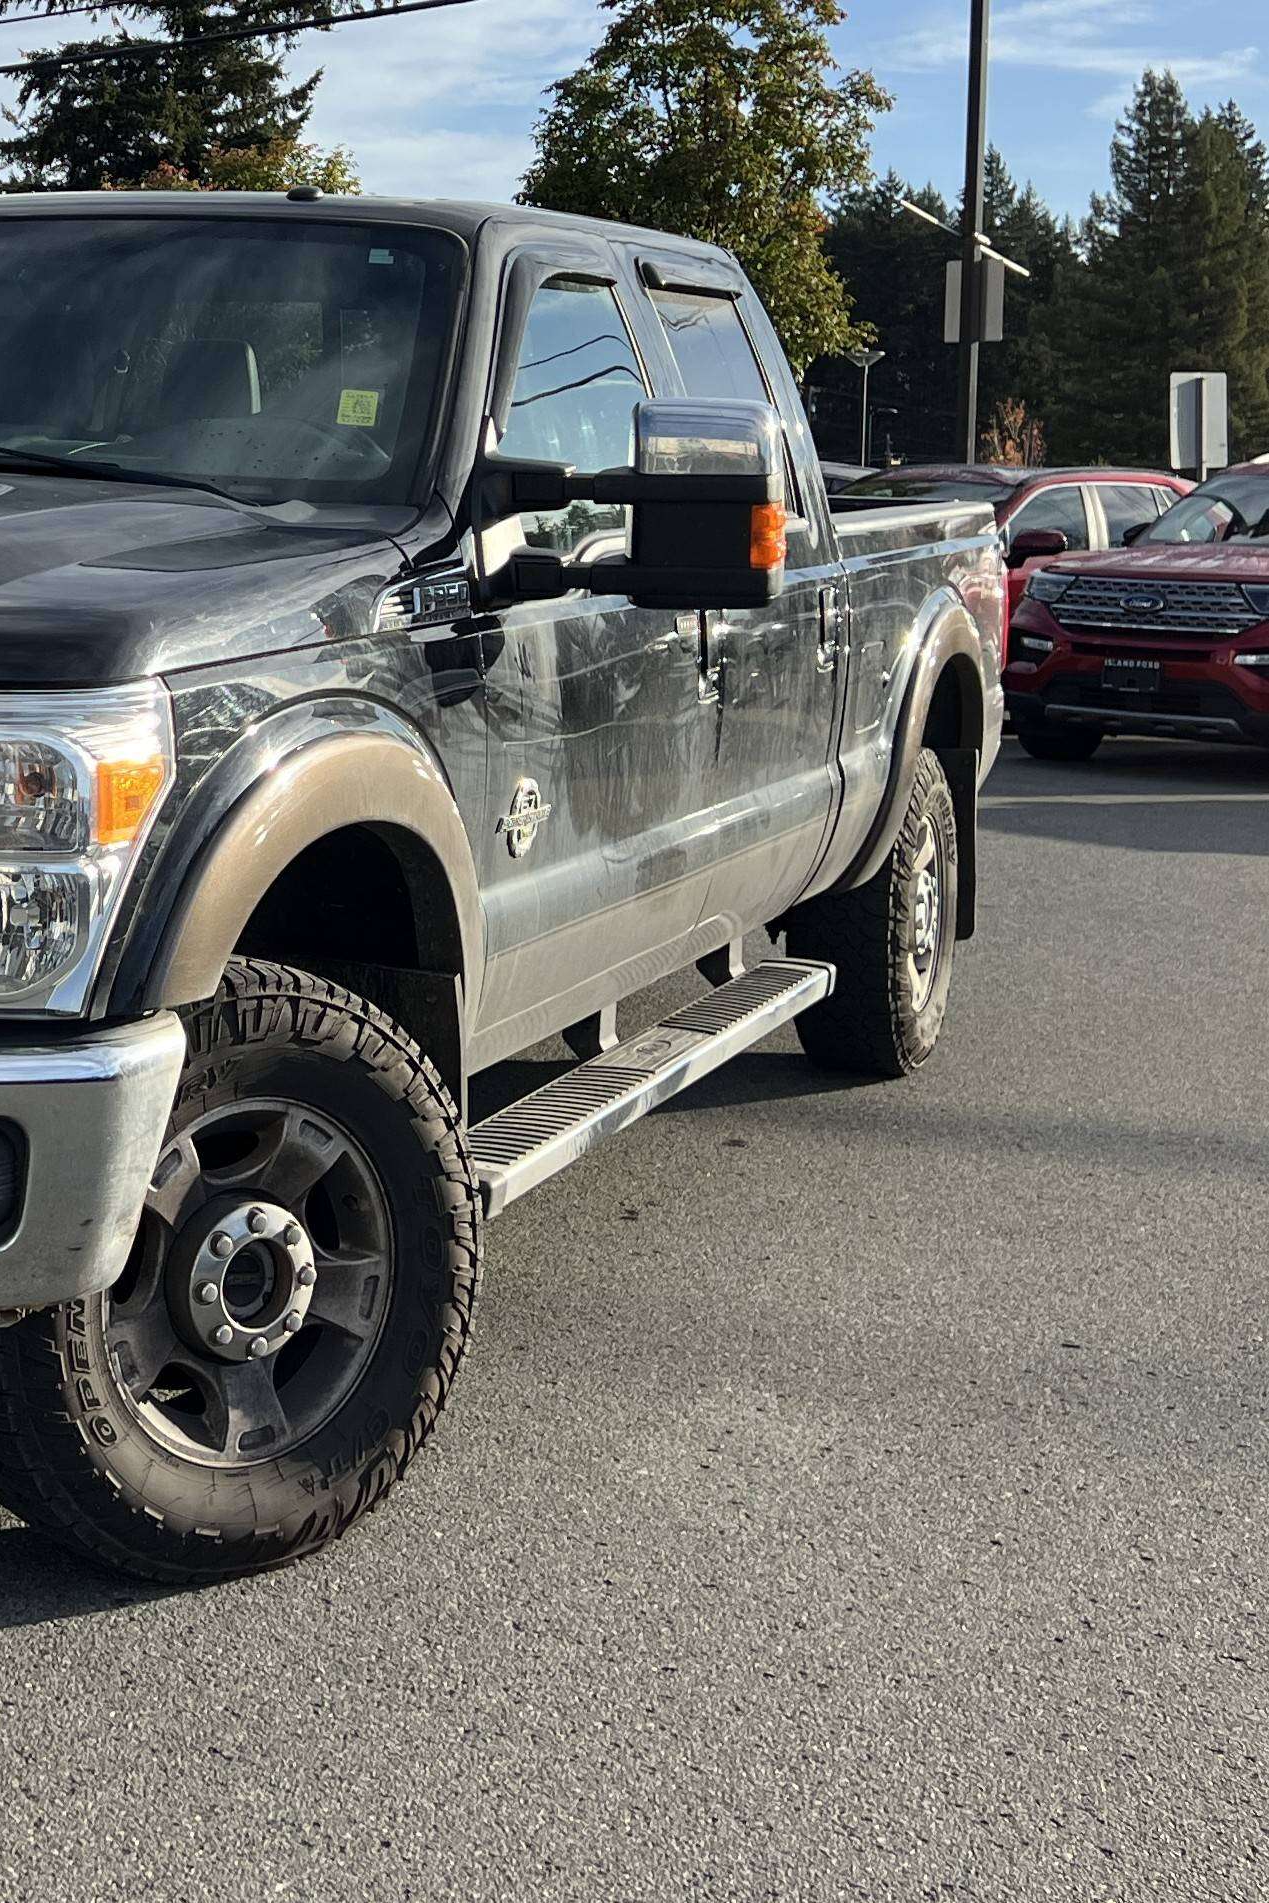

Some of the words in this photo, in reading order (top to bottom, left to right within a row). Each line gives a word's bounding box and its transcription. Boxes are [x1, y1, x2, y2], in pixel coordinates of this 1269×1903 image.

[1104, 658, 1134, 668] ISLAND
[1136, 660, 1160, 669] FORD
[65, 1297, 118, 1447] OPEN
